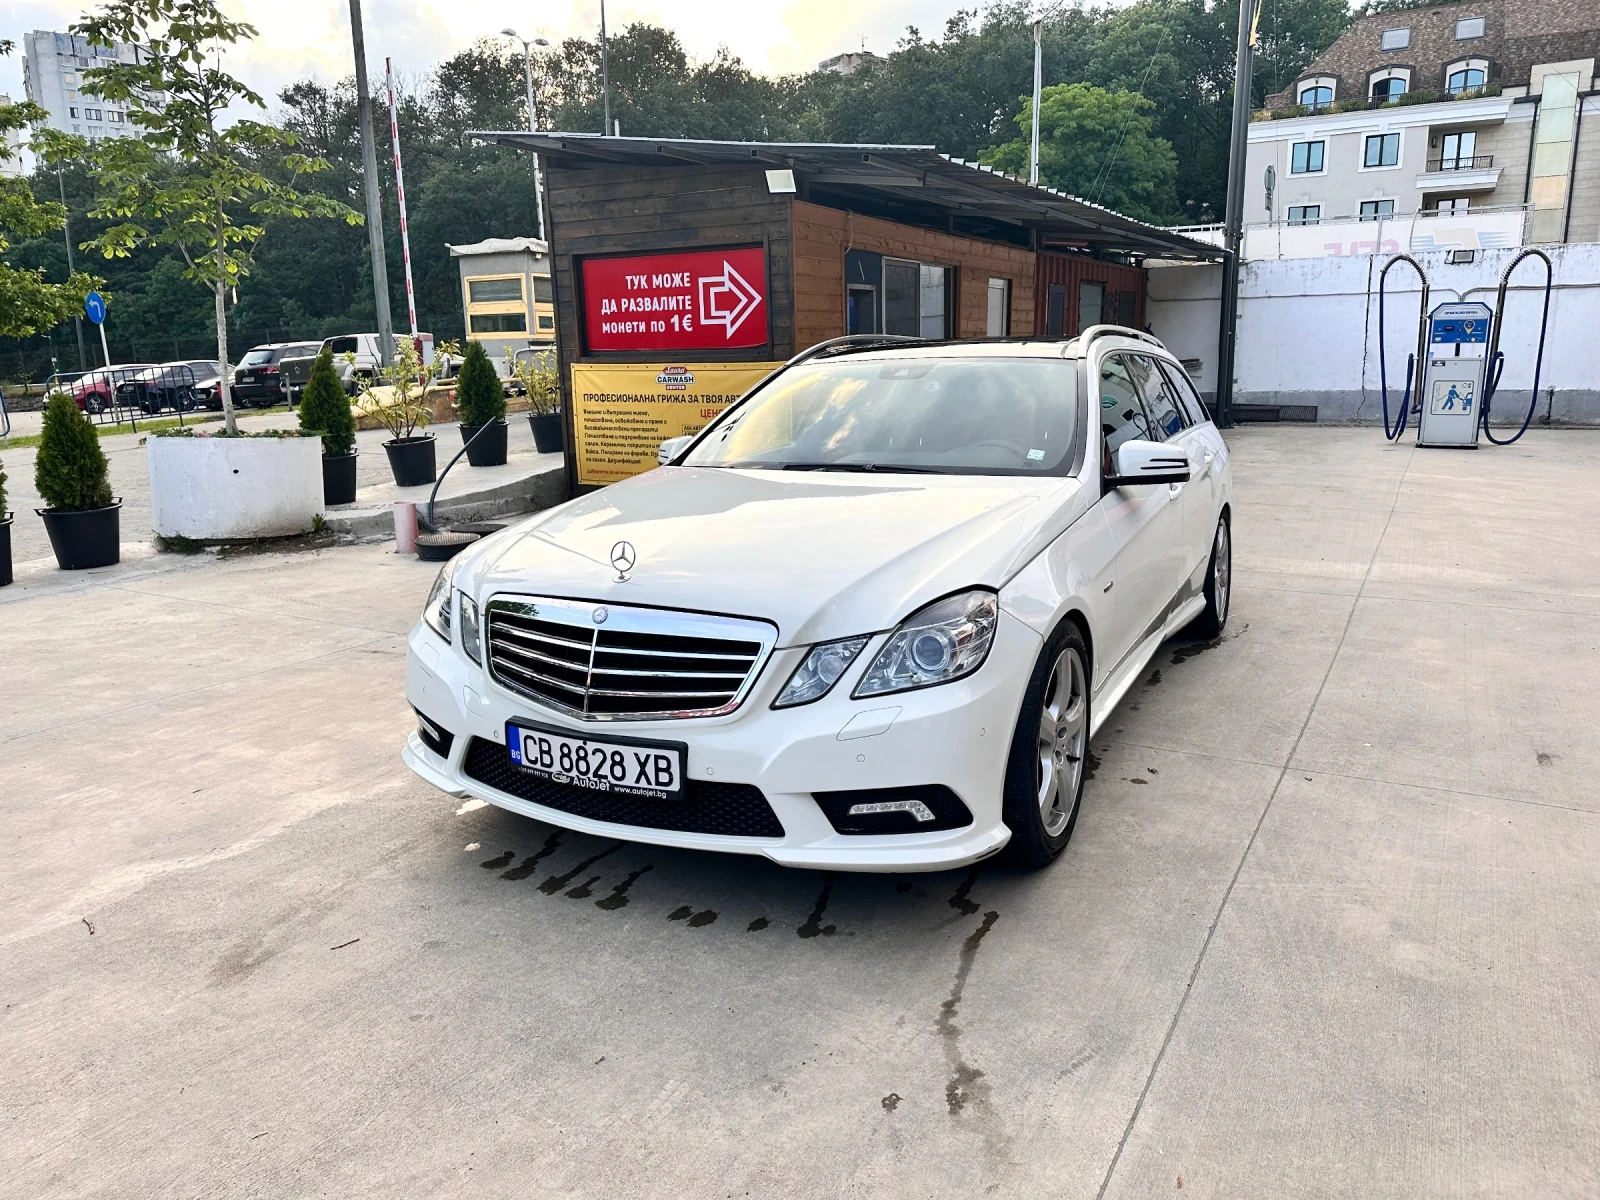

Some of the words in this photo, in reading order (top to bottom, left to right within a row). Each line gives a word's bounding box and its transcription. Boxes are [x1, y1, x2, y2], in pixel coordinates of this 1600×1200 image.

[626, 274, 648, 290] ТУК
[652, 272, 691, 289] МОЖЕ
[601, 298, 618, 315] ДА
[621, 295, 692, 312] РАЗВАЛИТЕ
[602, 321, 646, 334] монети
[650, 320, 665, 333] по
[670, 313, 693, 332] 1€
[583, 393, 656, 403] ПРОФЕСИОНАЛНА
[657, 394, 686, 403] ГРИЖА
[688, 394, 699, 404] ЗА
[701, 394, 723, 404] ТВОЯ
[511, 749, 521, 759] BG
[523, 734, 554, 769] CB
[559, 742, 627, 782] 8828
[633, 752, 674, 788] XB
[572, 776, 610, 792] AutoJet
[614, 786, 667, 799] www.autojet.bg
